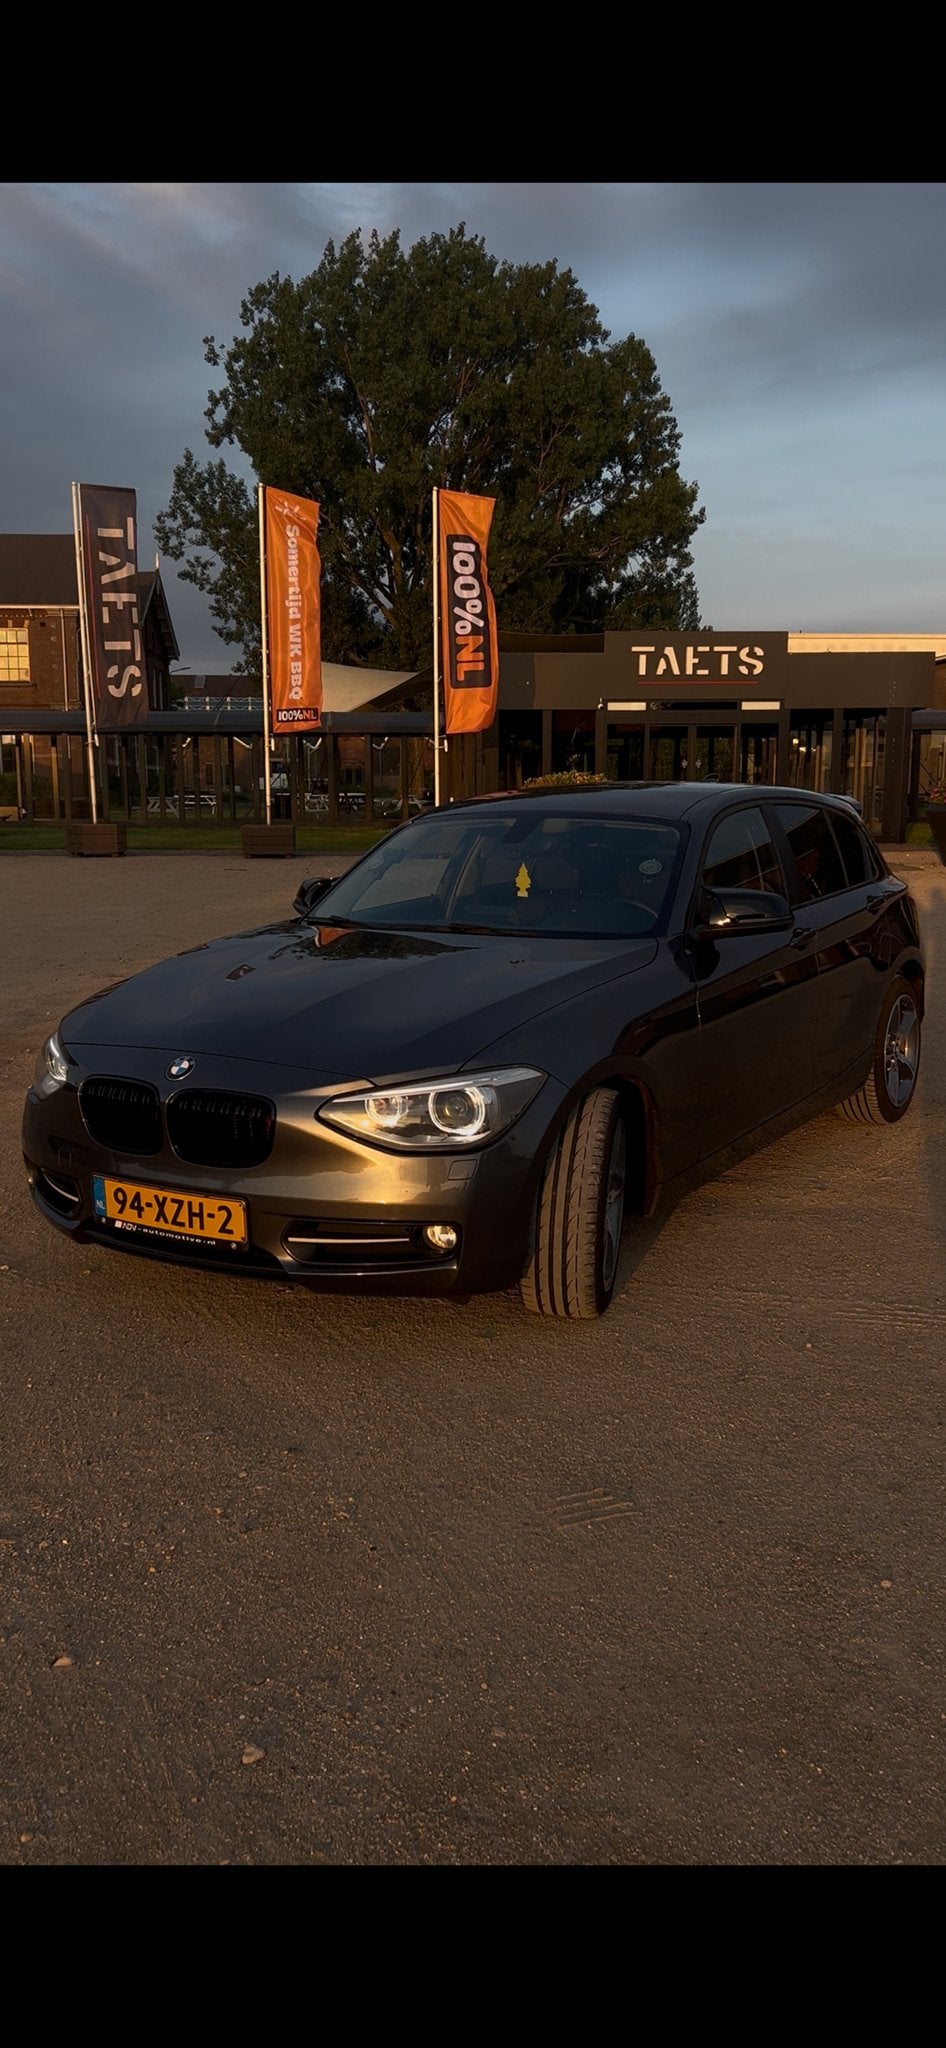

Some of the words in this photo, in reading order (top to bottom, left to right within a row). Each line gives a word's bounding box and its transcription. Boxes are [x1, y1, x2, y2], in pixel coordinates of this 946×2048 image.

[285, 524, 302, 619] Somertijd
[97, 516, 142, 698] TAETS
[452, 541, 485, 682] 100%NL
[288, 623, 303, 657] WK
[631, 645, 765, 676] TAETS
[288, 661, 304, 700] BBQ
[278, 709, 317, 721] 100%NL
[96, 1200, 106, 1210] NL
[113, 1187, 234, 1235] 94-XZH-2
